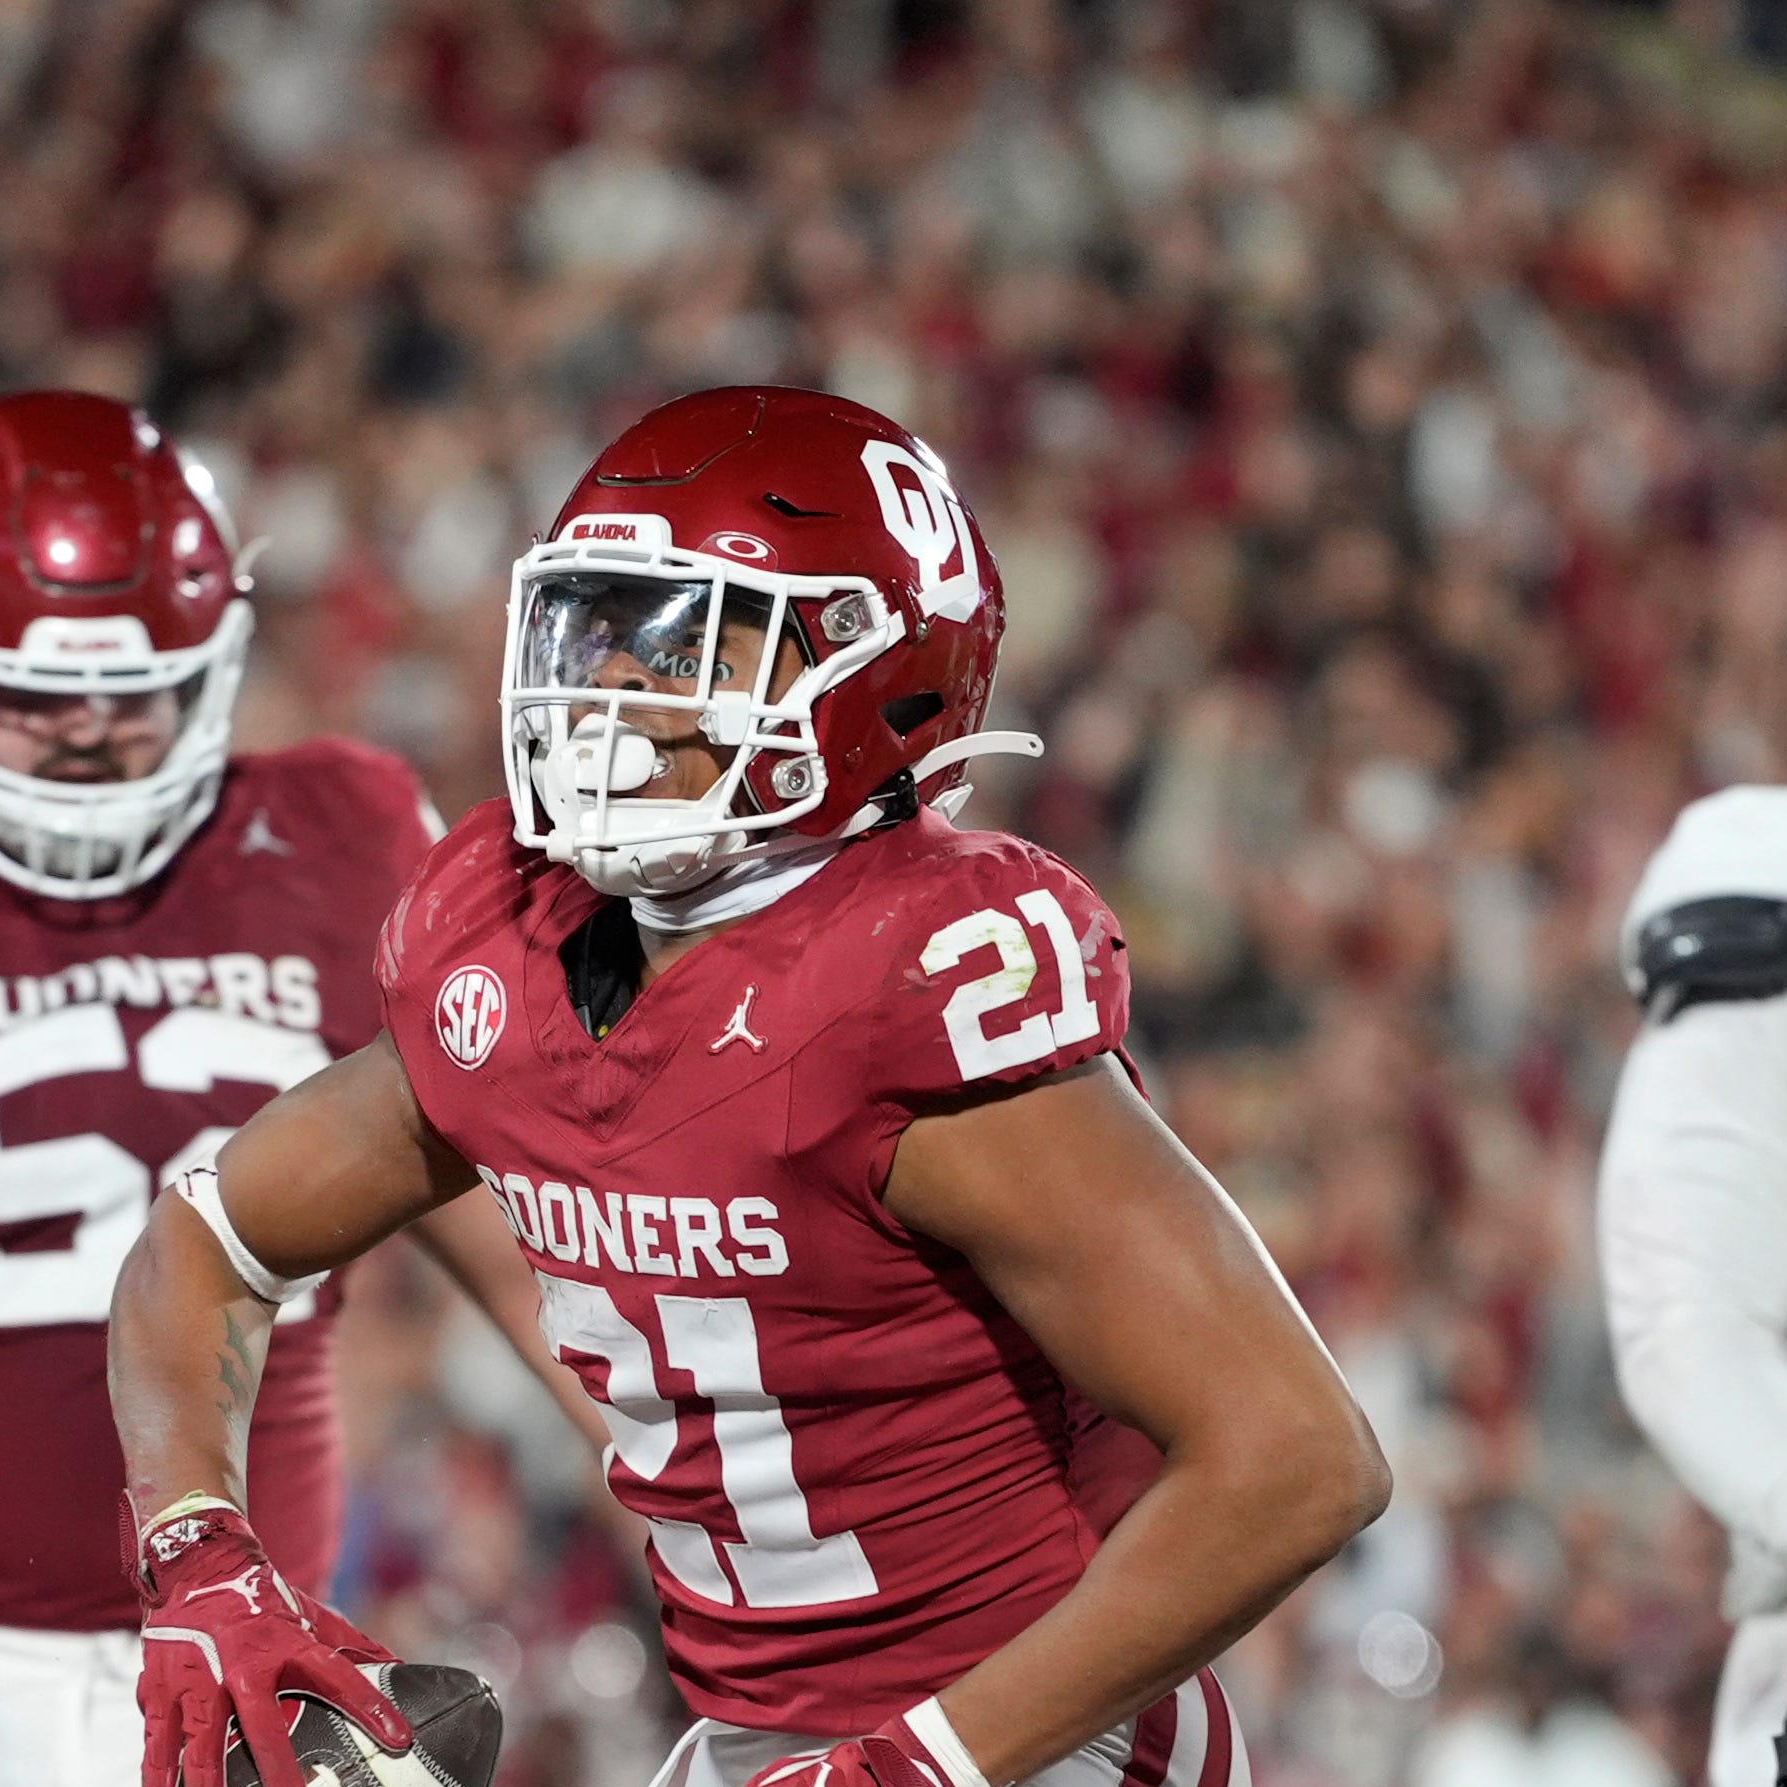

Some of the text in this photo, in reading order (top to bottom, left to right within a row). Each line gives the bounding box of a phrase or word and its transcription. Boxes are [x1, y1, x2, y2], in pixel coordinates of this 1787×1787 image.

[860, 439, 980, 624] OU
[442, 973, 501, 1061] SEC
[919, 888, 1101, 1082] 21
[476, 1163, 790, 1279] SOONERS
[536, 1268, 881, 1609] 21
